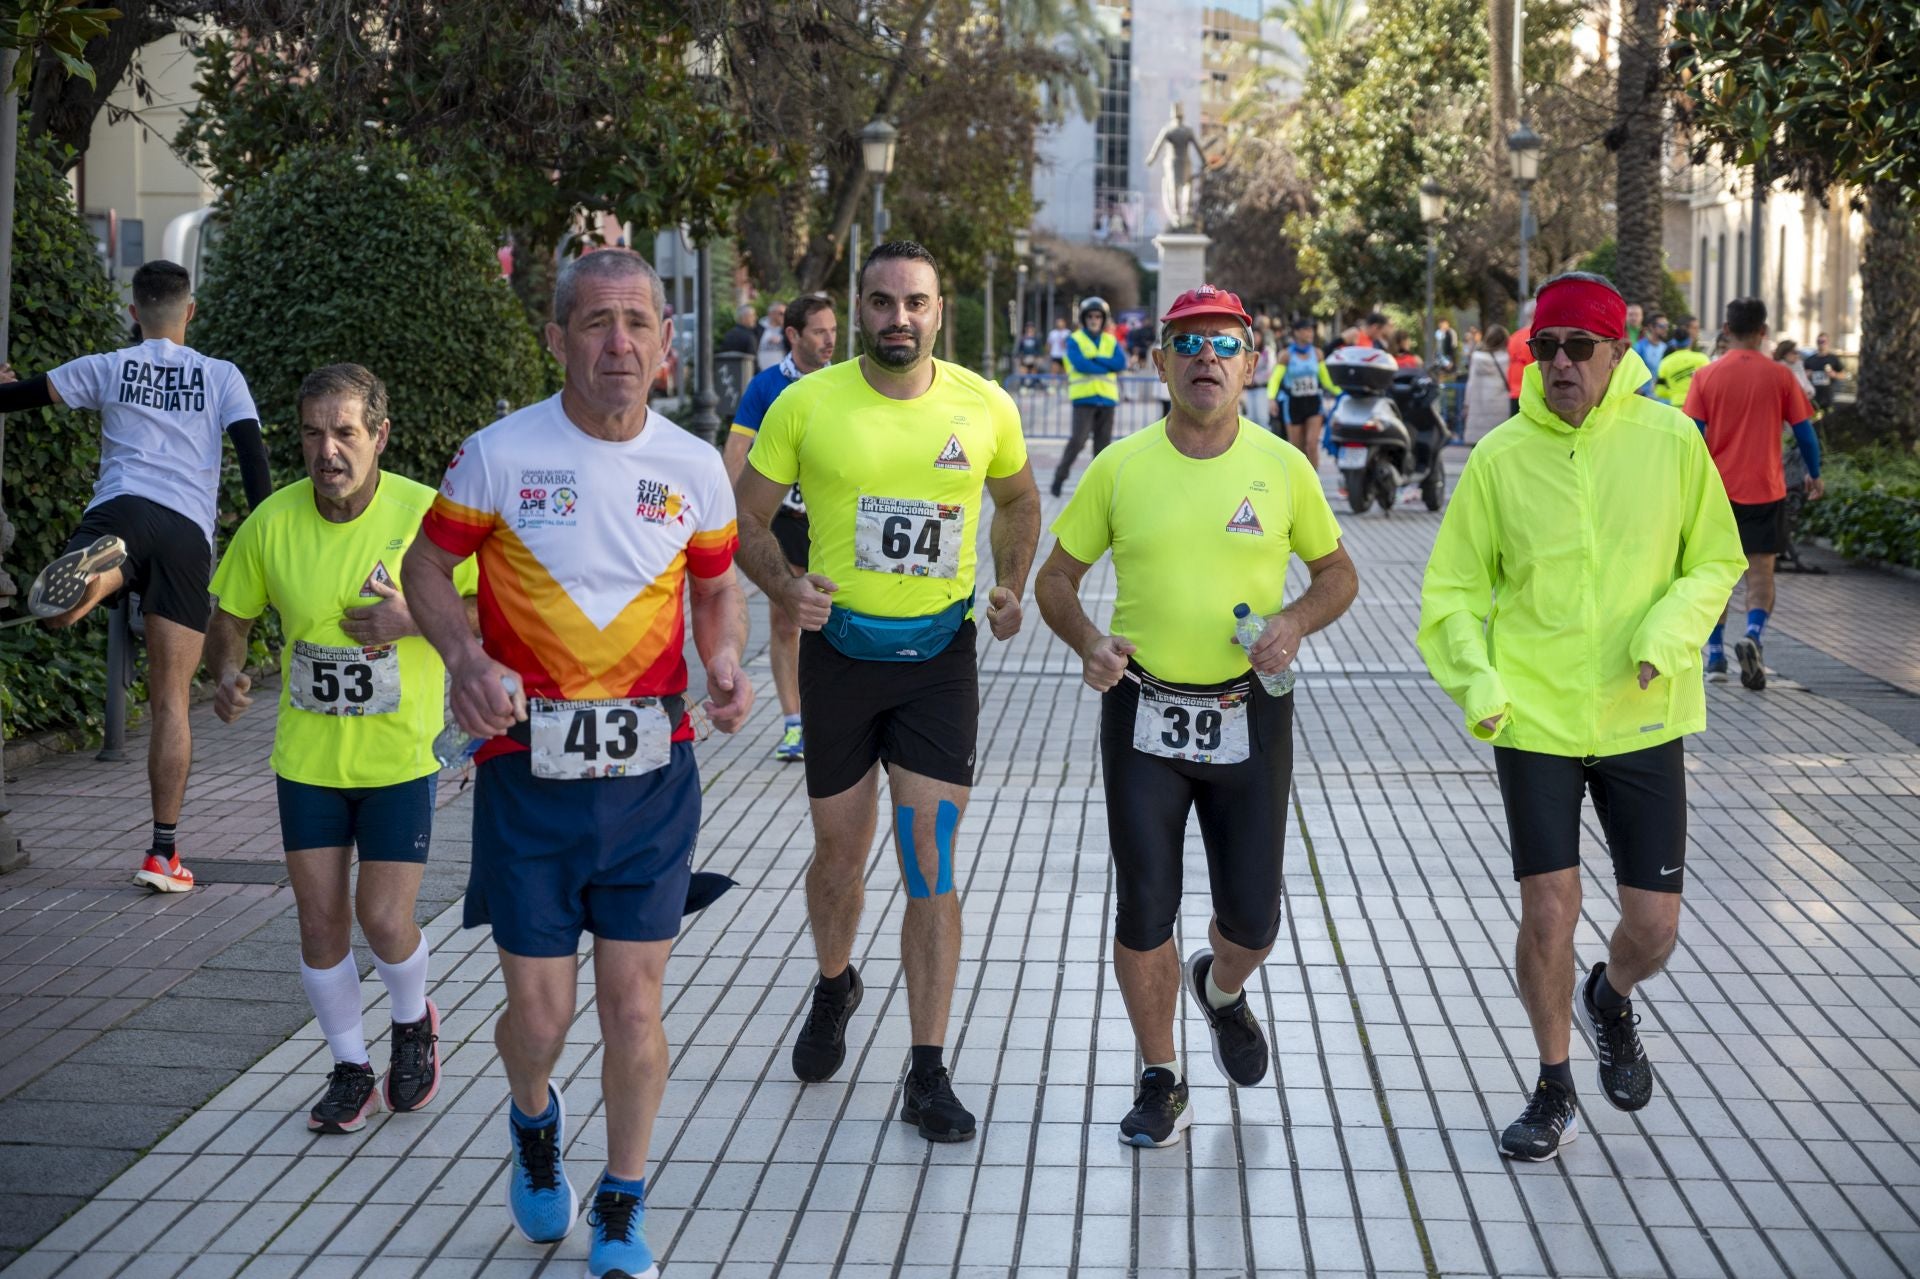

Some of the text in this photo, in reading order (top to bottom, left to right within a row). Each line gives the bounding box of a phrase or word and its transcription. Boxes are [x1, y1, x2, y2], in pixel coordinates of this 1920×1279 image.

[122, 360, 204, 391] GAZELA
[119, 382, 205, 412] IMEDIATO
[521, 474, 577, 485] COIMBRA
[519, 488, 547, 500] GO
[519, 500, 546, 510] APE
[637, 491, 668, 507] MER
[636, 503, 667, 520] RUN
[863, 502, 934, 517] INTERNACIONAL
[881, 515, 942, 563] 64
[312, 661, 374, 703] 53
[564, 708, 639, 761] 43
[1161, 706, 1222, 750] 39
